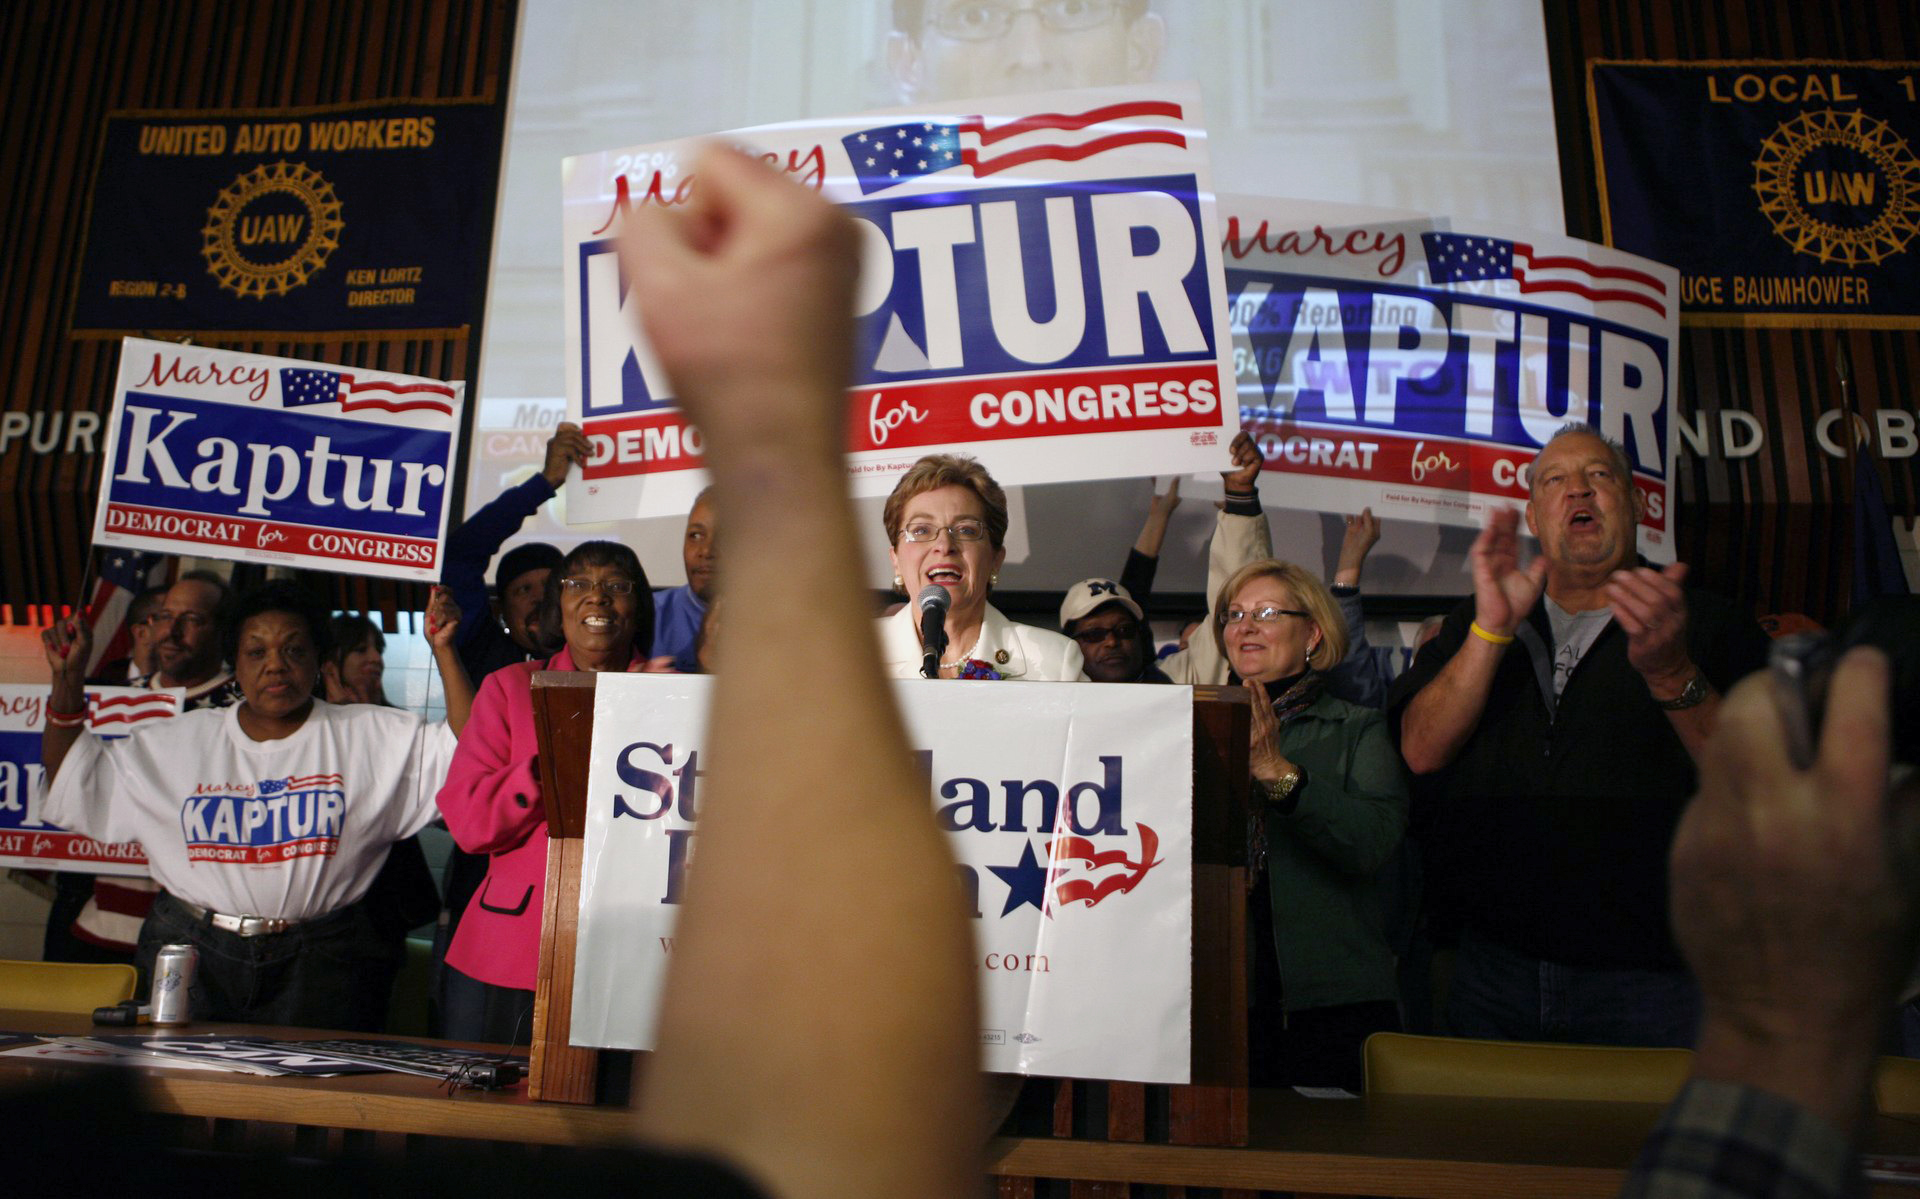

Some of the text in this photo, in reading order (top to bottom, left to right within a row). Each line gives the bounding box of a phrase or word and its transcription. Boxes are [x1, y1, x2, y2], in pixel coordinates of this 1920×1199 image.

[1707, 73, 1858, 103] LOCAL
[139, 117, 437, 155] UNITED AUTO WORKERS
[1804, 170, 1876, 206] UAW
[241, 214, 304, 245] UAW
[1221, 216, 1406, 277] Marcy
[109, 280, 158, 297] REGION
[346, 269, 376, 285] KEN
[1733, 276, 1870, 305] BAUMHOWER
[347, 287, 416, 307] DIRECTOR
[134, 352, 270, 402] Marcy
[868, 394, 929, 446] for
[970, 378, 1218, 429] CONGRESS
[0, 411, 112, 453] PUR
[115, 404, 445, 516] Kaptur
[1410, 440, 1461, 482] for
[108, 506, 246, 541] DEMOCRAT
[256, 520, 289, 548] for
[307, 532, 434, 563] CONGRESS
[193, 782, 255, 797] Marcy
[182, 792, 345, 844] KAPTUR
[31, 834, 52, 857] for
[189, 846, 248, 861] DEMOCRAT
[256, 850, 273, 863] for
